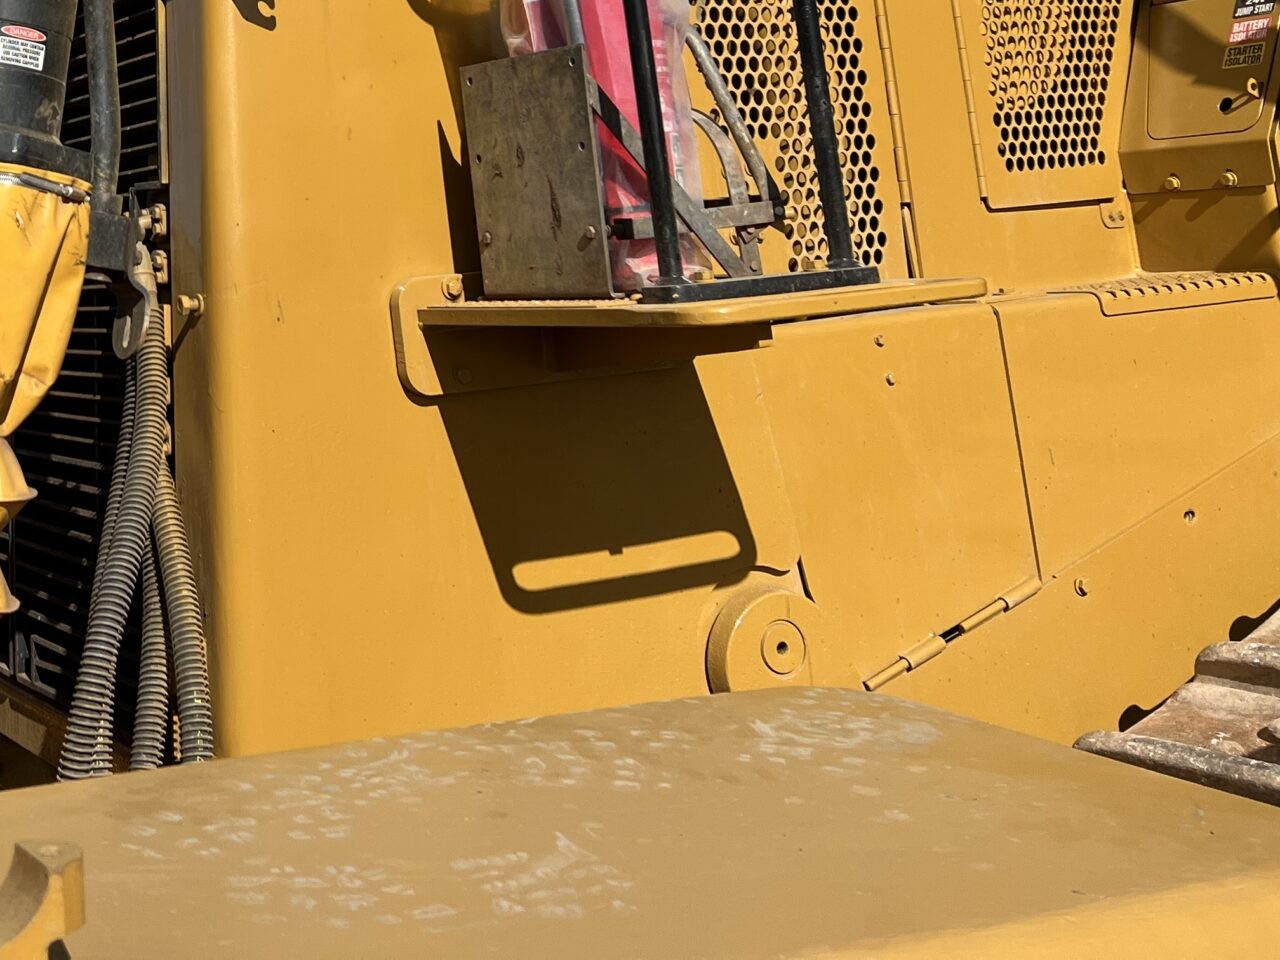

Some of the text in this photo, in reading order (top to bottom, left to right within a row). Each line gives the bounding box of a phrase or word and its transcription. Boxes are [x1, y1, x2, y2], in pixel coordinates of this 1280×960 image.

[1234, 3, 1274, 17] JUMP START
[1232, 18, 1270, 33] BATTERY
[1229, 29, 1268, 43] ISOLATOR
[1227, 43, 1264, 58] STARTER
[1224, 55, 1262, 68] ISOLATOR
